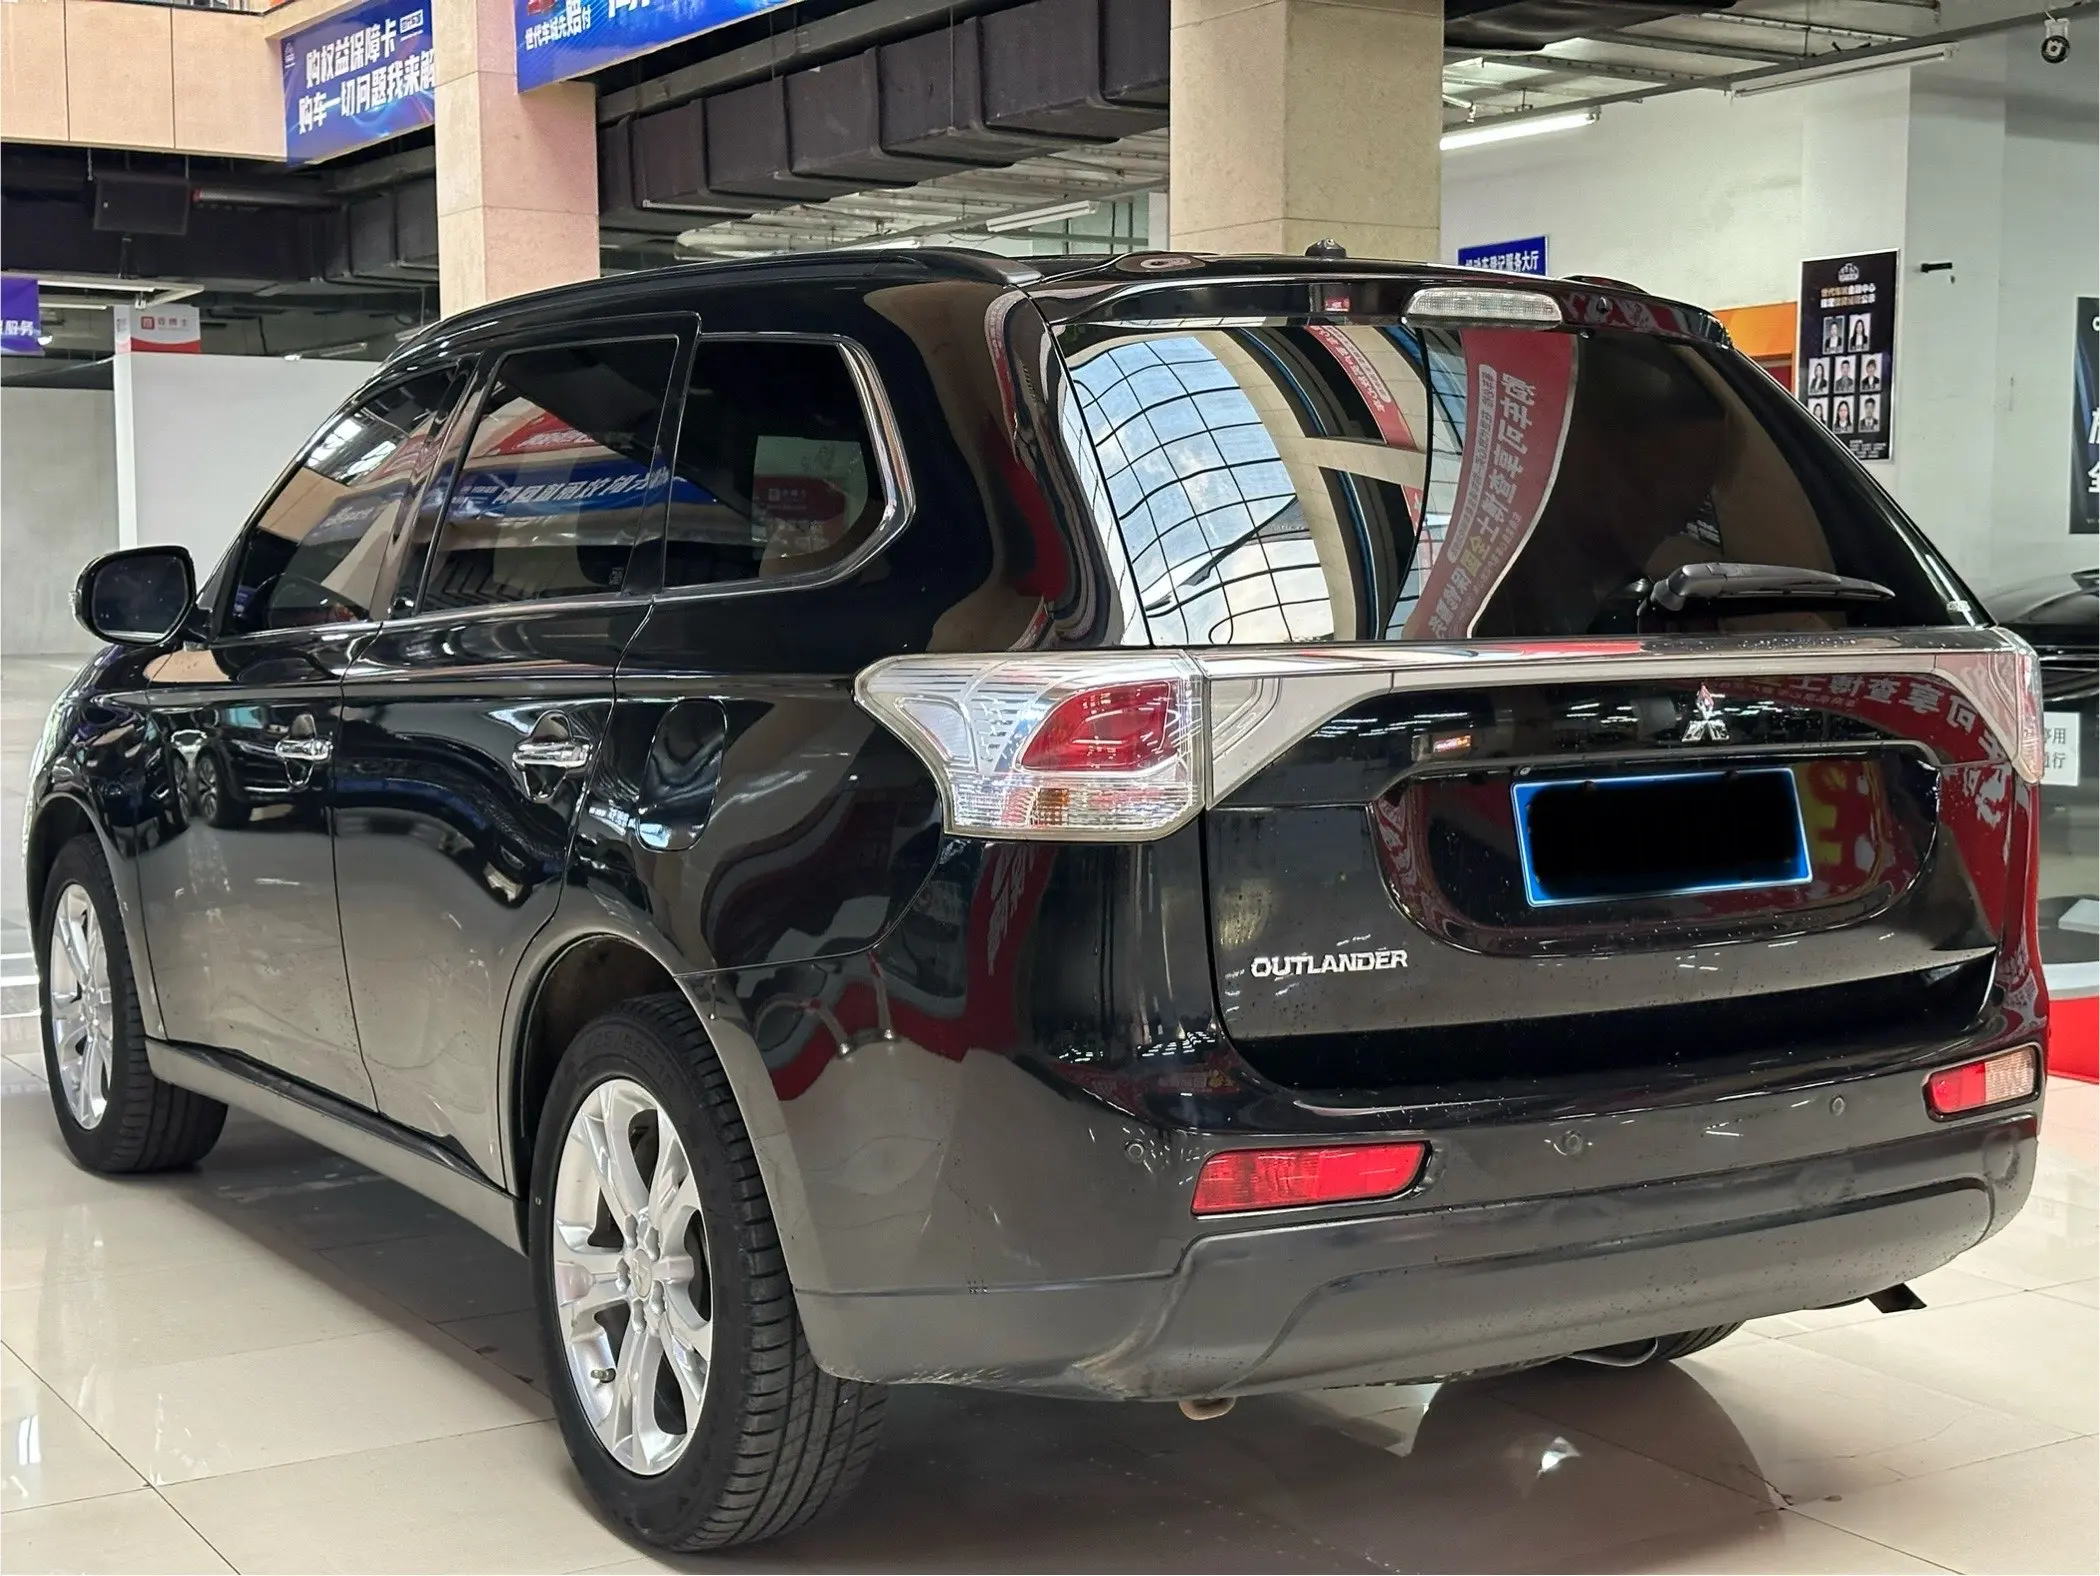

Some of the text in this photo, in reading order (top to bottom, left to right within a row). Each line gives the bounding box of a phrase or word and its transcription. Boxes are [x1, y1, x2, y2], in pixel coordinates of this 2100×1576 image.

[305, 18, 397, 89] 购权益保障卡
[298, 48, 435, 135] 购车一切问题我来解
[2, 319, 34, 337] 服务
[1251, 949, 1409, 978] OUTLANDER
